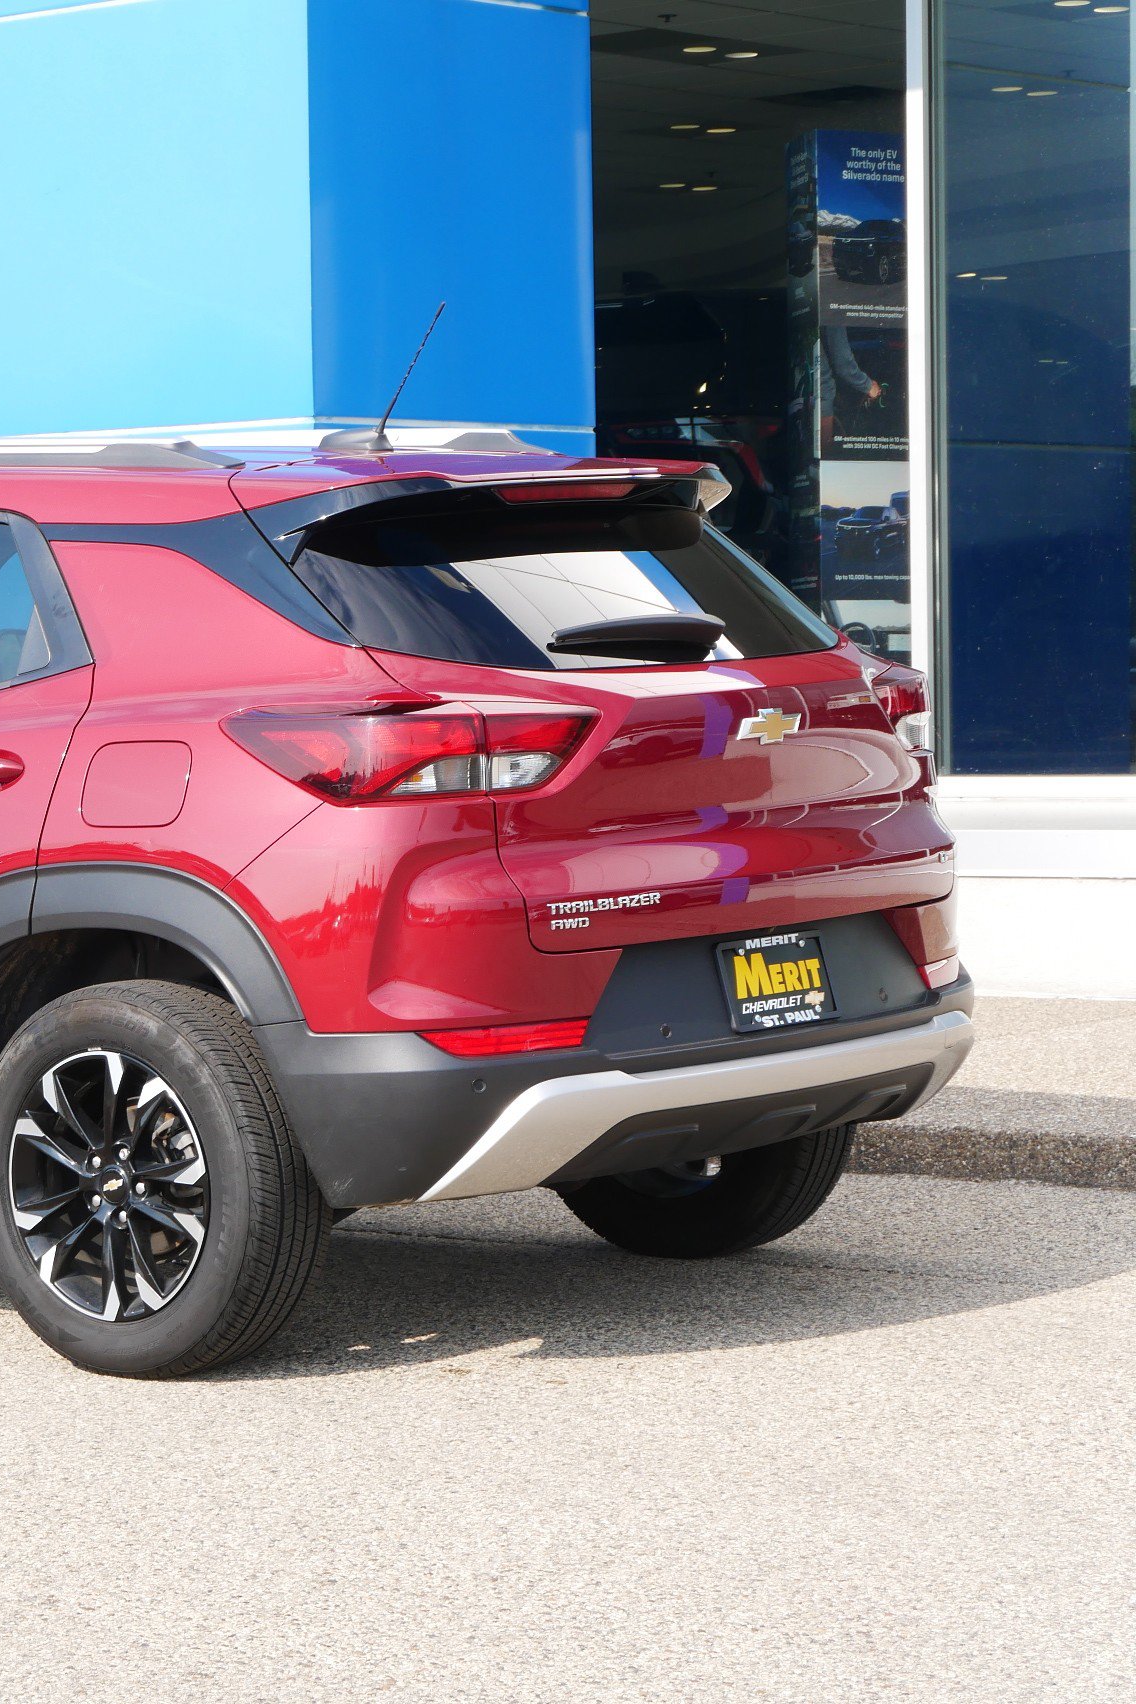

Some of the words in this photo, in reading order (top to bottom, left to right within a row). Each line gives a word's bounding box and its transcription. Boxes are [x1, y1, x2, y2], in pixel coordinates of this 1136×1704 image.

[850, 147, 866, 158] The
[867, 149, 885, 160] only
[886, 149, 898, 159] EV
[846, 160, 876, 171] worthy
[877, 161, 886, 170] of
[887, 161, 901, 171] the
[842, 170, 881, 181] Silverado
[882, 174, 905, 183] name
[546, 892, 661, 915] TRAILBLAZER
[550, 917, 590, 931] AWD
[745, 933, 799, 950] MERIT
[733, 952, 822, 1000] MERIT
[742, 995, 803, 1015] CHEVROLET
[761, 1014, 785, 1028] ST.
[784, 1008, 820, 1024] PAUL
